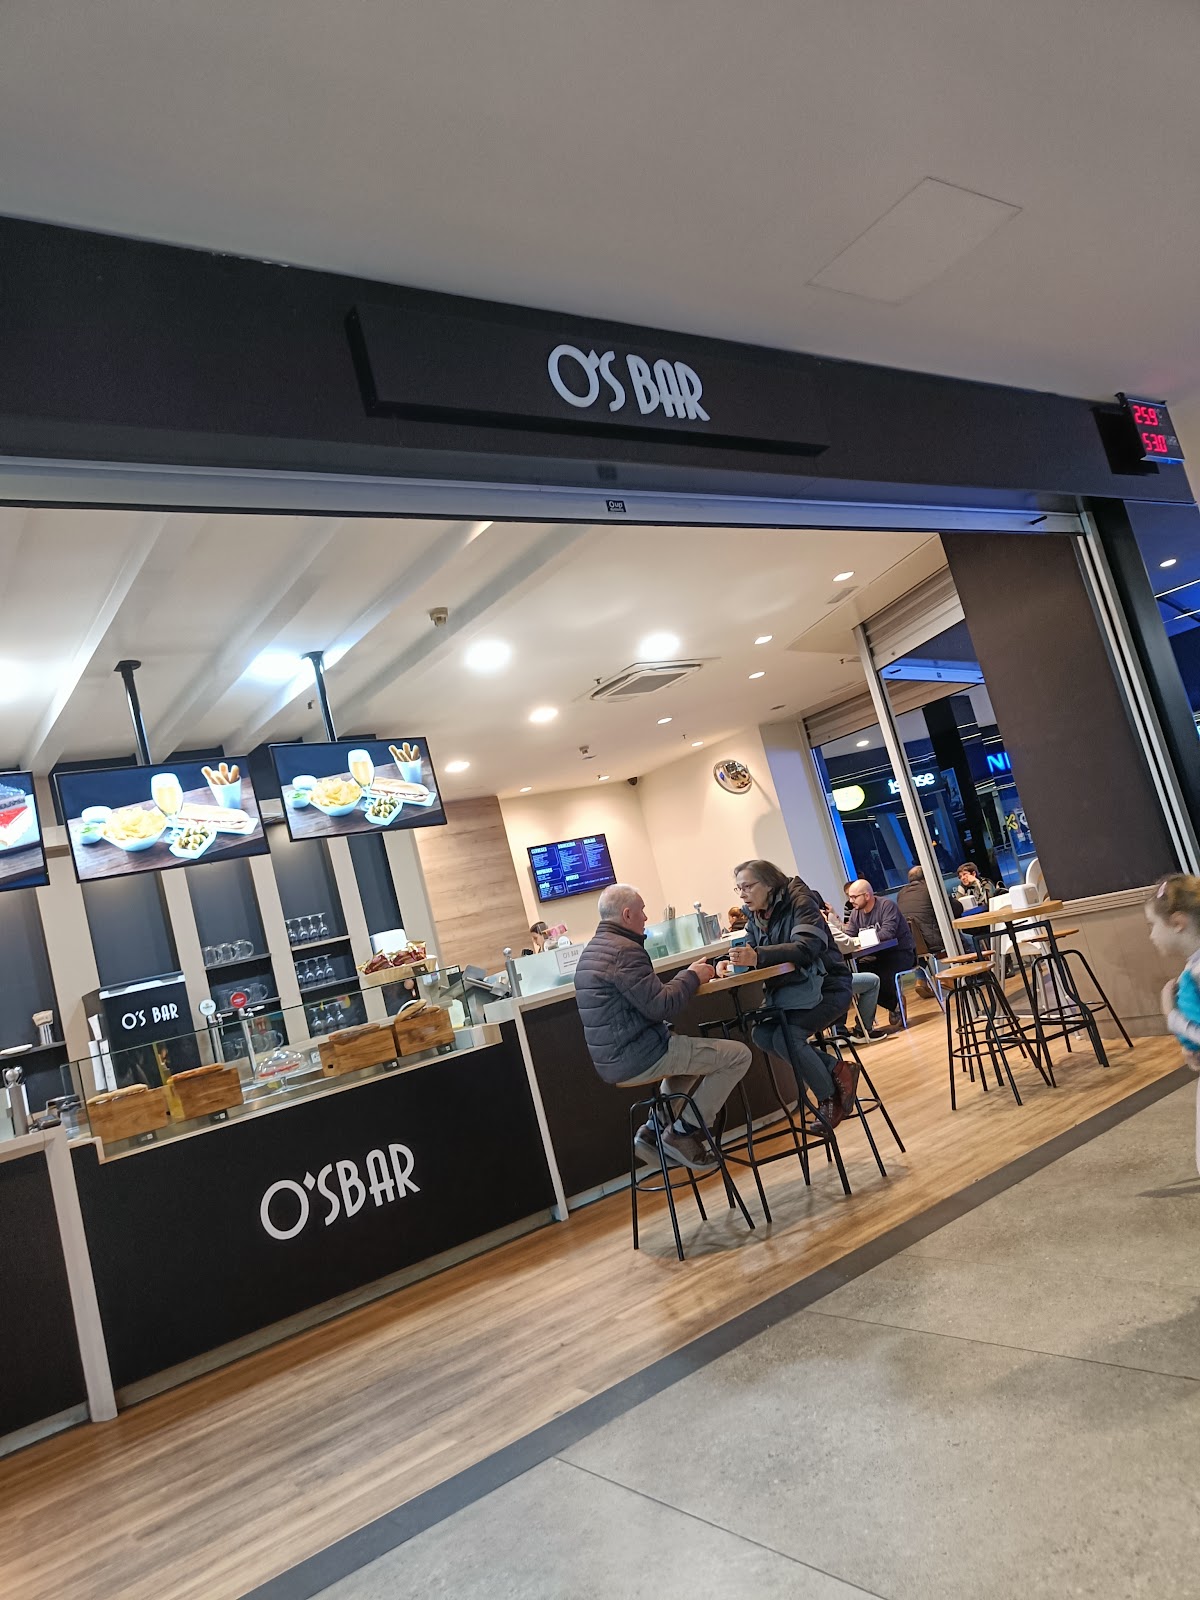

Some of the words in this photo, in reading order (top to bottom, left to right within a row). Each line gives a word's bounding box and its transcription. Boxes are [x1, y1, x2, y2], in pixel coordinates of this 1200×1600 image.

[547, 344, 626, 412] O'S
[625, 354, 711, 421] BAR
[121, 1009, 147, 1030] O'S
[151, 1003, 179, 1023] BAR
